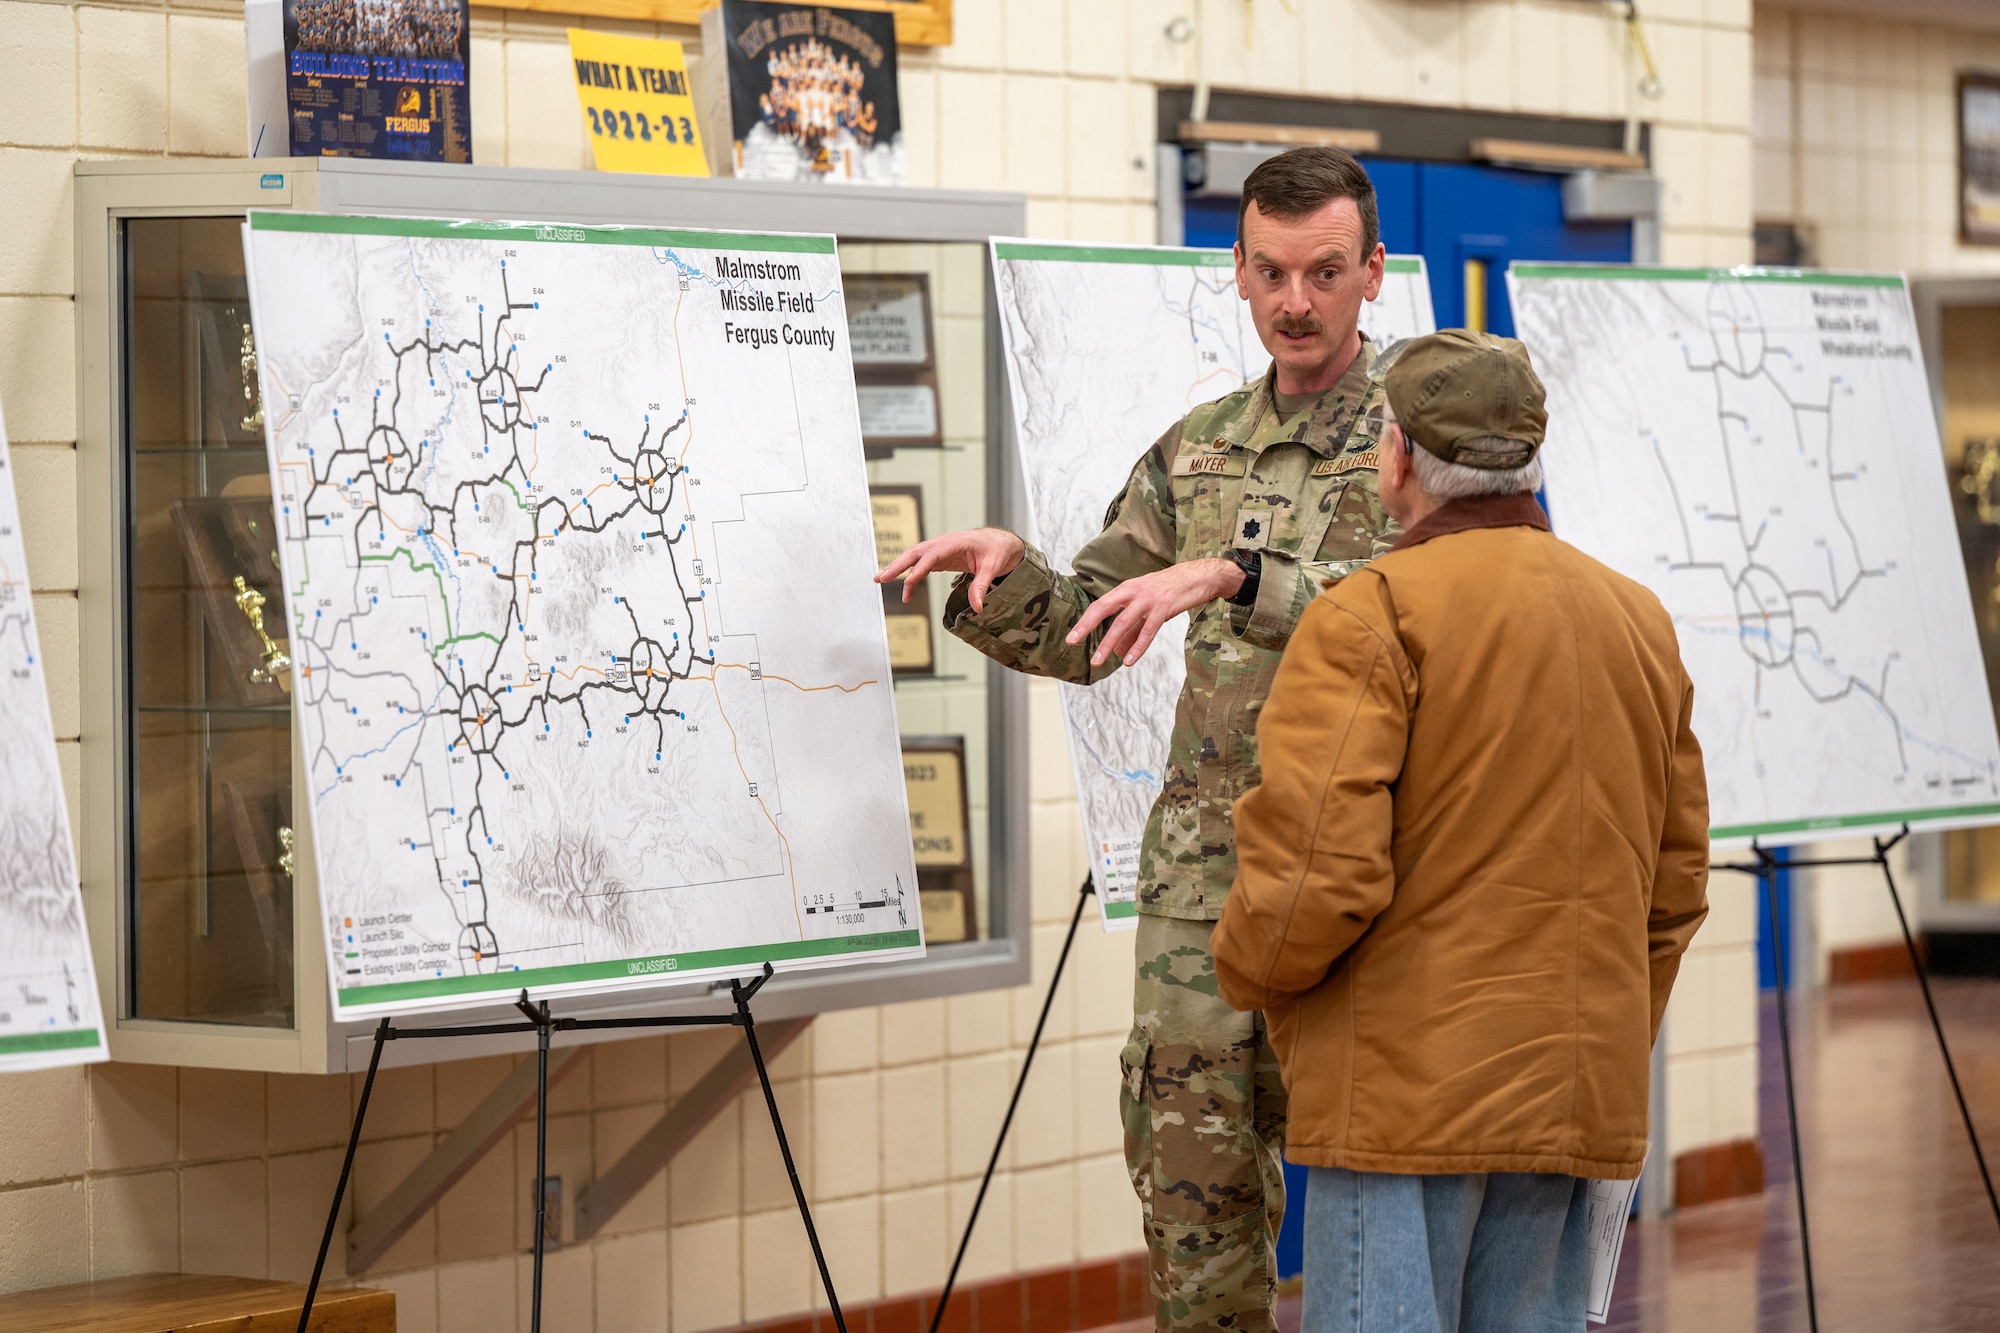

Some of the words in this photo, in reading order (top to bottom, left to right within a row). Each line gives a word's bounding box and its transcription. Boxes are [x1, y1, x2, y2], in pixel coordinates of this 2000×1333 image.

[777, 11, 815, 38] ARE
[291, 51, 370, 80] BUILDING
[373, 56, 465, 86] TRADITION
[575, 58, 621, 90] WHAT
[627, 65, 638, 92] A
[639, 67, 688, 97] YEAR!
[385, 117, 431, 133] FERGUS
[587, 106, 695, 146] 2022-23
[535, 227, 586, 242] UNCLASSIFIED
[715, 256, 802, 281] Malmstrom
[720, 289, 774, 313] Missile
[778, 290, 815, 314] Field
[725, 322, 778, 350] Fergus
[782, 323, 835, 351] County
[1189, 457, 1227, 473] MAYER
[1352, 451, 1379, 469] FORC
[803, 895, 808, 905] 0
[814, 894, 824, 904] 2.5
[830, 893, 835, 903] 5
[855, 890, 863, 901] 10
[881, 888, 889, 898] 15
[885, 896, 901, 907] Miles
[359, 914, 386, 927] Launch
[388, 913, 413, 924] Center
[836, 913, 865, 926] 1:130,000
[361, 930, 388, 943] Launch
[400, 945, 420, 957] Utility
[395, 961, 416, 974] Utility
[628, 958, 678, 975] UNCLASSIFIED
